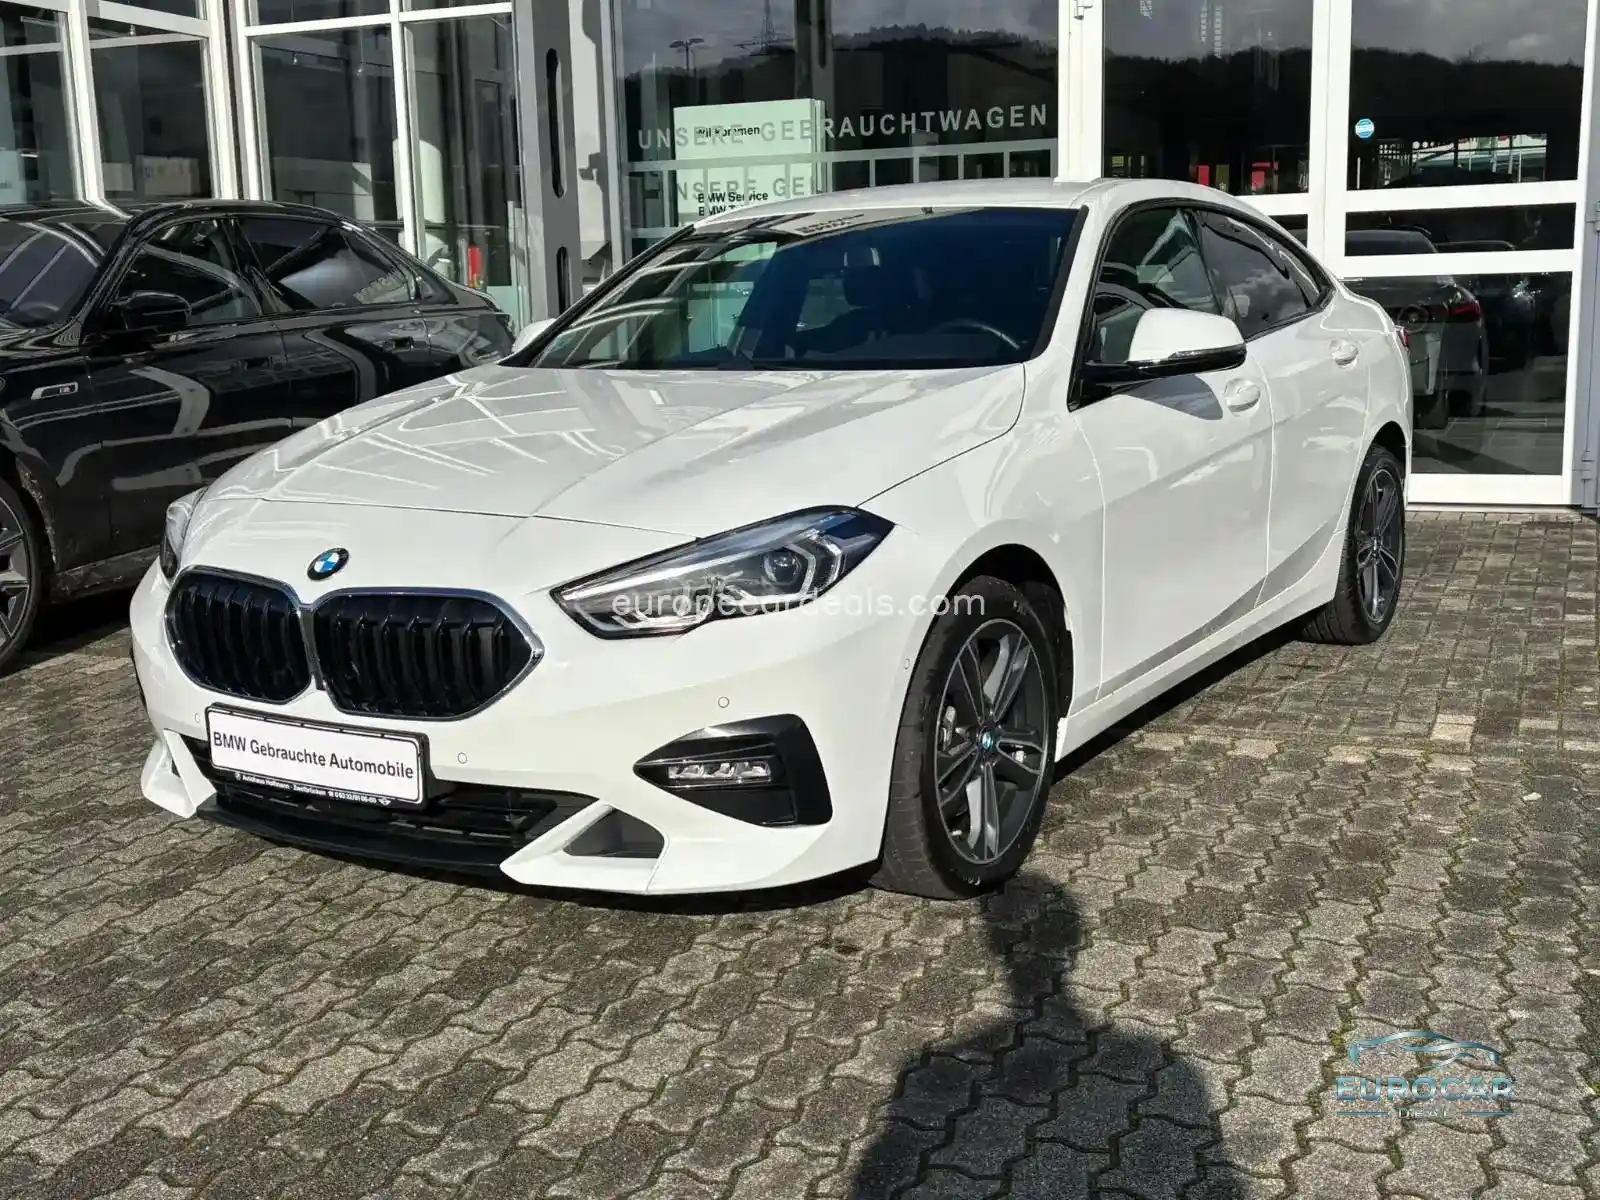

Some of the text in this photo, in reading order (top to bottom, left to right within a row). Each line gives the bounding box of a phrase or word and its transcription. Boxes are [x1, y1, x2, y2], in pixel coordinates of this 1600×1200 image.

[638, 103, 1048, 149] UNSERE GEBRAUCHTWAGEN
[696, 125, 760, 139] Wilkommen
[697, 191, 727, 204] BMW
[212, 731, 414, 779] BMW Gebrauchte Automobile
